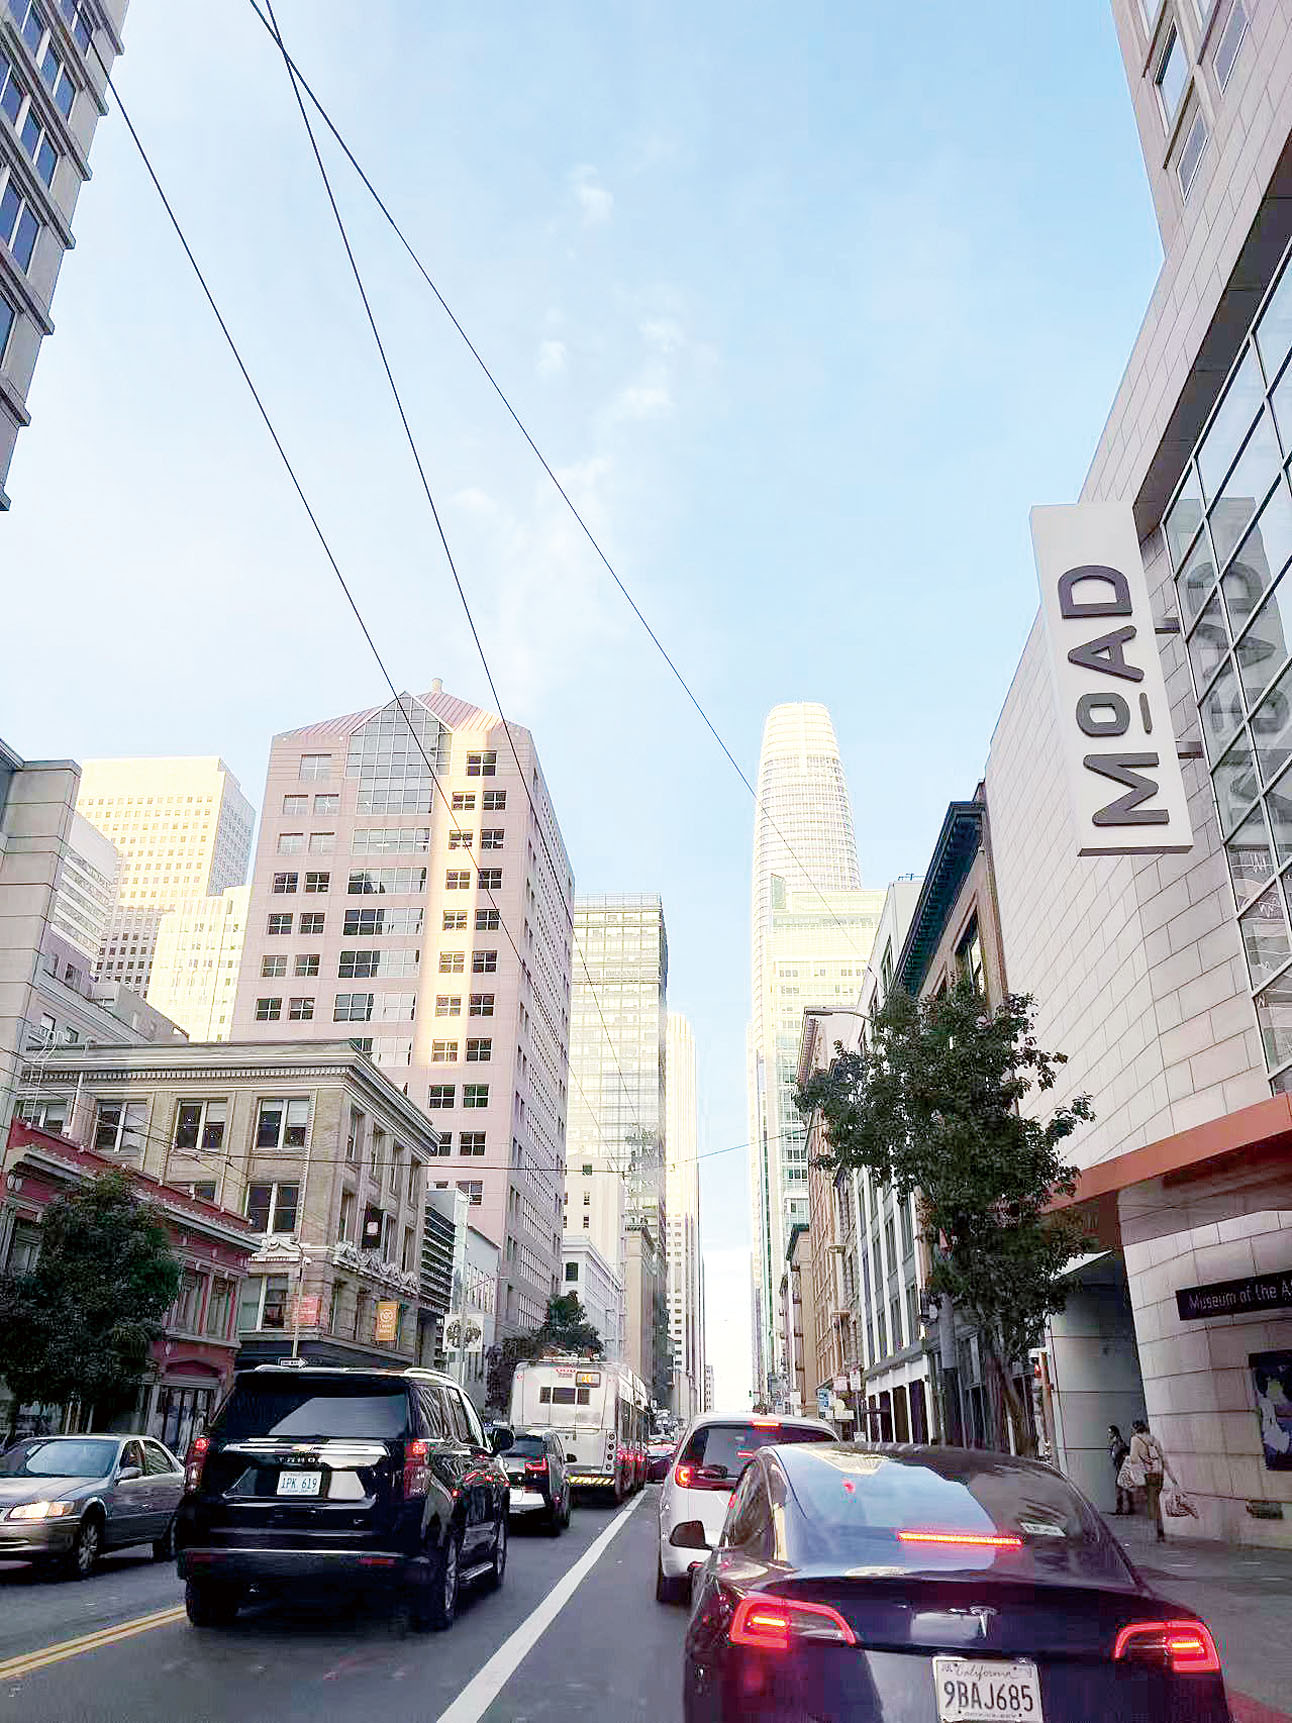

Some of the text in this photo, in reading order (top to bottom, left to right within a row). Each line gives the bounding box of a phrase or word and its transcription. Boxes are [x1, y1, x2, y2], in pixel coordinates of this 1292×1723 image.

[1188, 1279, 1292, 1309] Museum of the A
[956, 1664, 1011, 1680] California
[944, 1681, 1033, 1712] 9BAJ685
